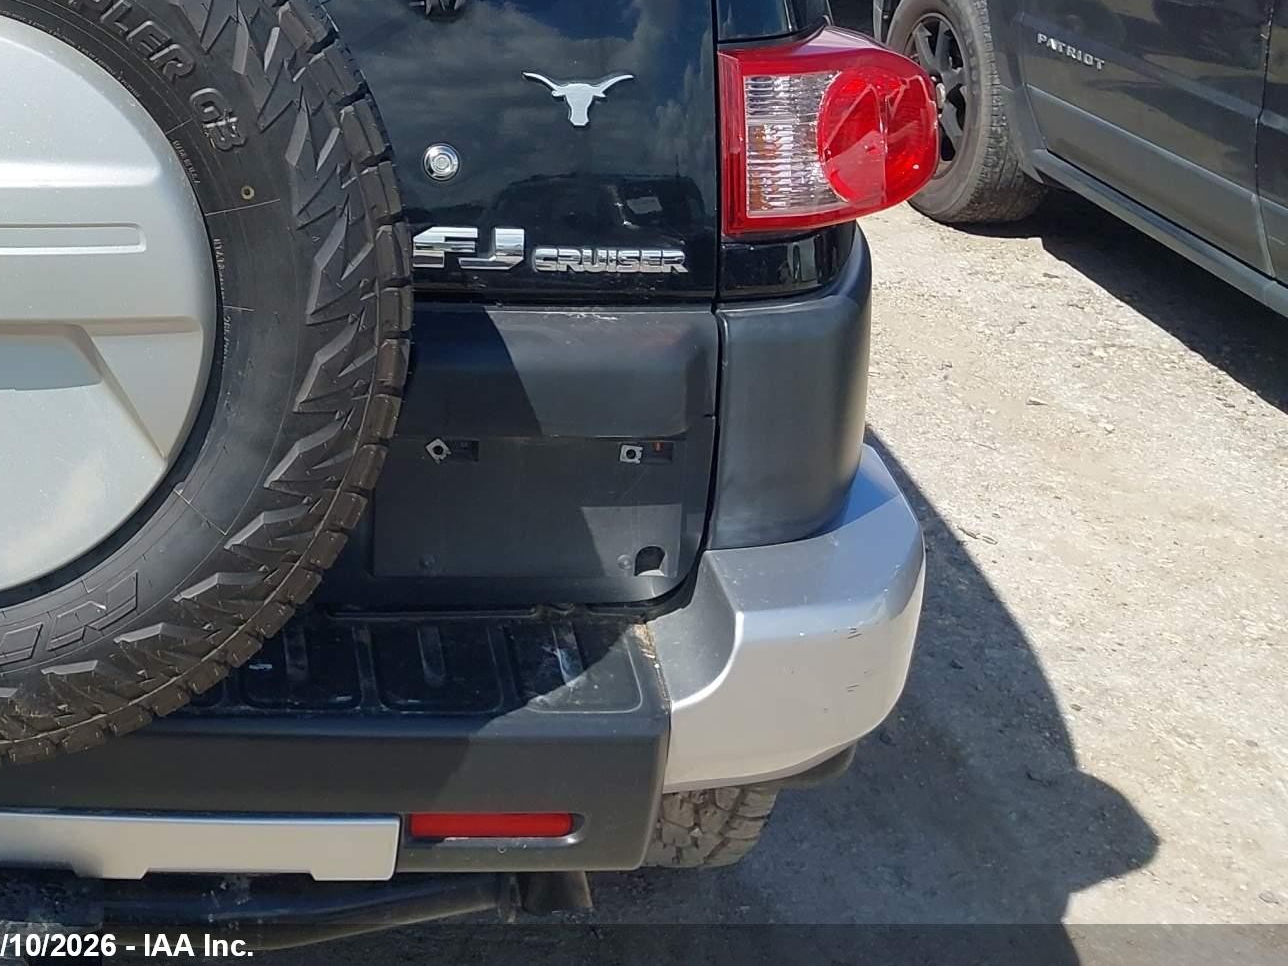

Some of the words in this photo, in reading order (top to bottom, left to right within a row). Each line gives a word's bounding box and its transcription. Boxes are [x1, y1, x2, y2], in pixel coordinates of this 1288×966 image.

[1037, 32, 1105, 70] PATRIOT
[412, 226, 525, 271] FJ
[533, 247, 689, 273] CRUISER
